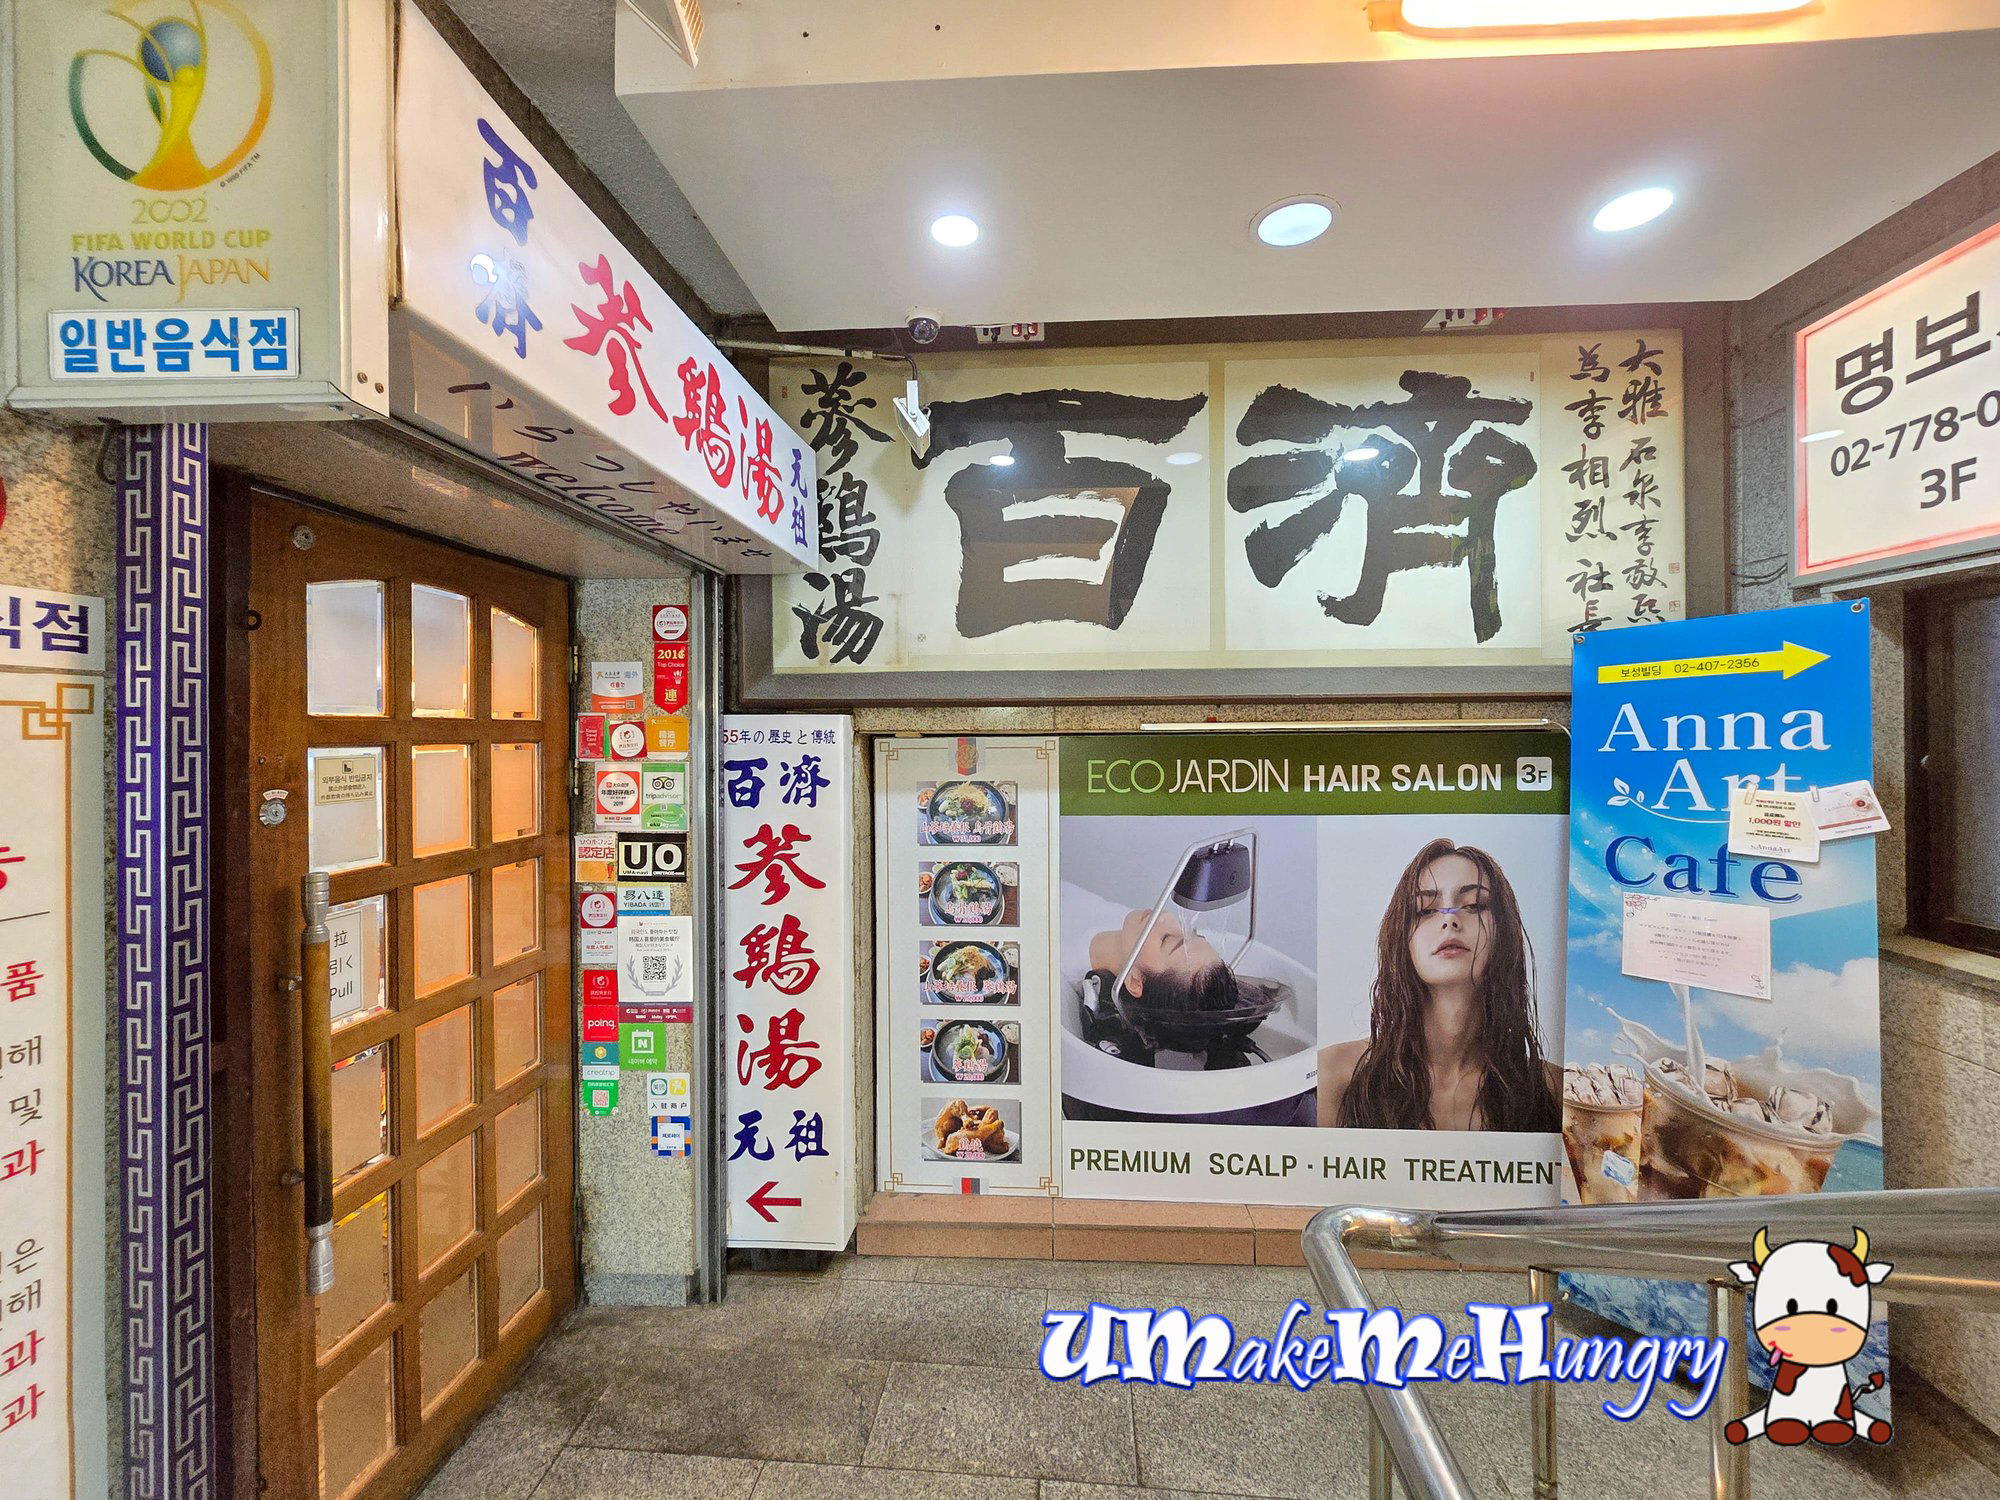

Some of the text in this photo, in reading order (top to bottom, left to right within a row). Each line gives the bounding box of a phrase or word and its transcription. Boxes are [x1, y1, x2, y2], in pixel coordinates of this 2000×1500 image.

[131, 197, 208, 224] 2002
[71, 229, 271, 252] FIFA WORLD CUP
[72, 254, 271, 303] KOREA JAPAN
[60, 316, 288, 374] 일반음식점
[1835, 290, 2000, 416] 명보
[447, 381, 773, 558] いらっしゃいませ
[1920, 456, 1977, 509] 3F
[791, 448, 808, 548] 元祖
[909, 369, 1538, 645] 百濟
[1621, 657, 1760, 679] 보성빌딩 02-407-2356
[1598, 702, 1832, 752] Anna
[322, 775, 347, 784] 외부음식
[646, 792, 679, 800] tripadvisor
[724, 754, 831, 808] 百濟
[1303, 763, 1379, 793] HAIR
[1391, 763, 1502, 792] SALON
[1520, 764, 1548, 784] 3F
[1749, 817, 1801, 828] 1,000원 할인
[578, 847, 615, 859] 認定店
[1604, 835, 1803, 904] Cafe
[334, 930, 348, 948] 拉
[330, 954, 353, 975] 引く
[0, 1035, 42, 1070] 해
[637, 1038, 648, 1048] N
[9, 1088, 42, 1126] 및
[727, 1109, 829, 1163] 元祖
[1070, 1148, 1191, 1175] PREMIUM
[1209, 1152, 1297, 1178] SCALP
[1323, 1156, 1388, 1181] HAIR
[0, 1238, 44, 1276] 은
[0, 1279, 42, 1316] 해
